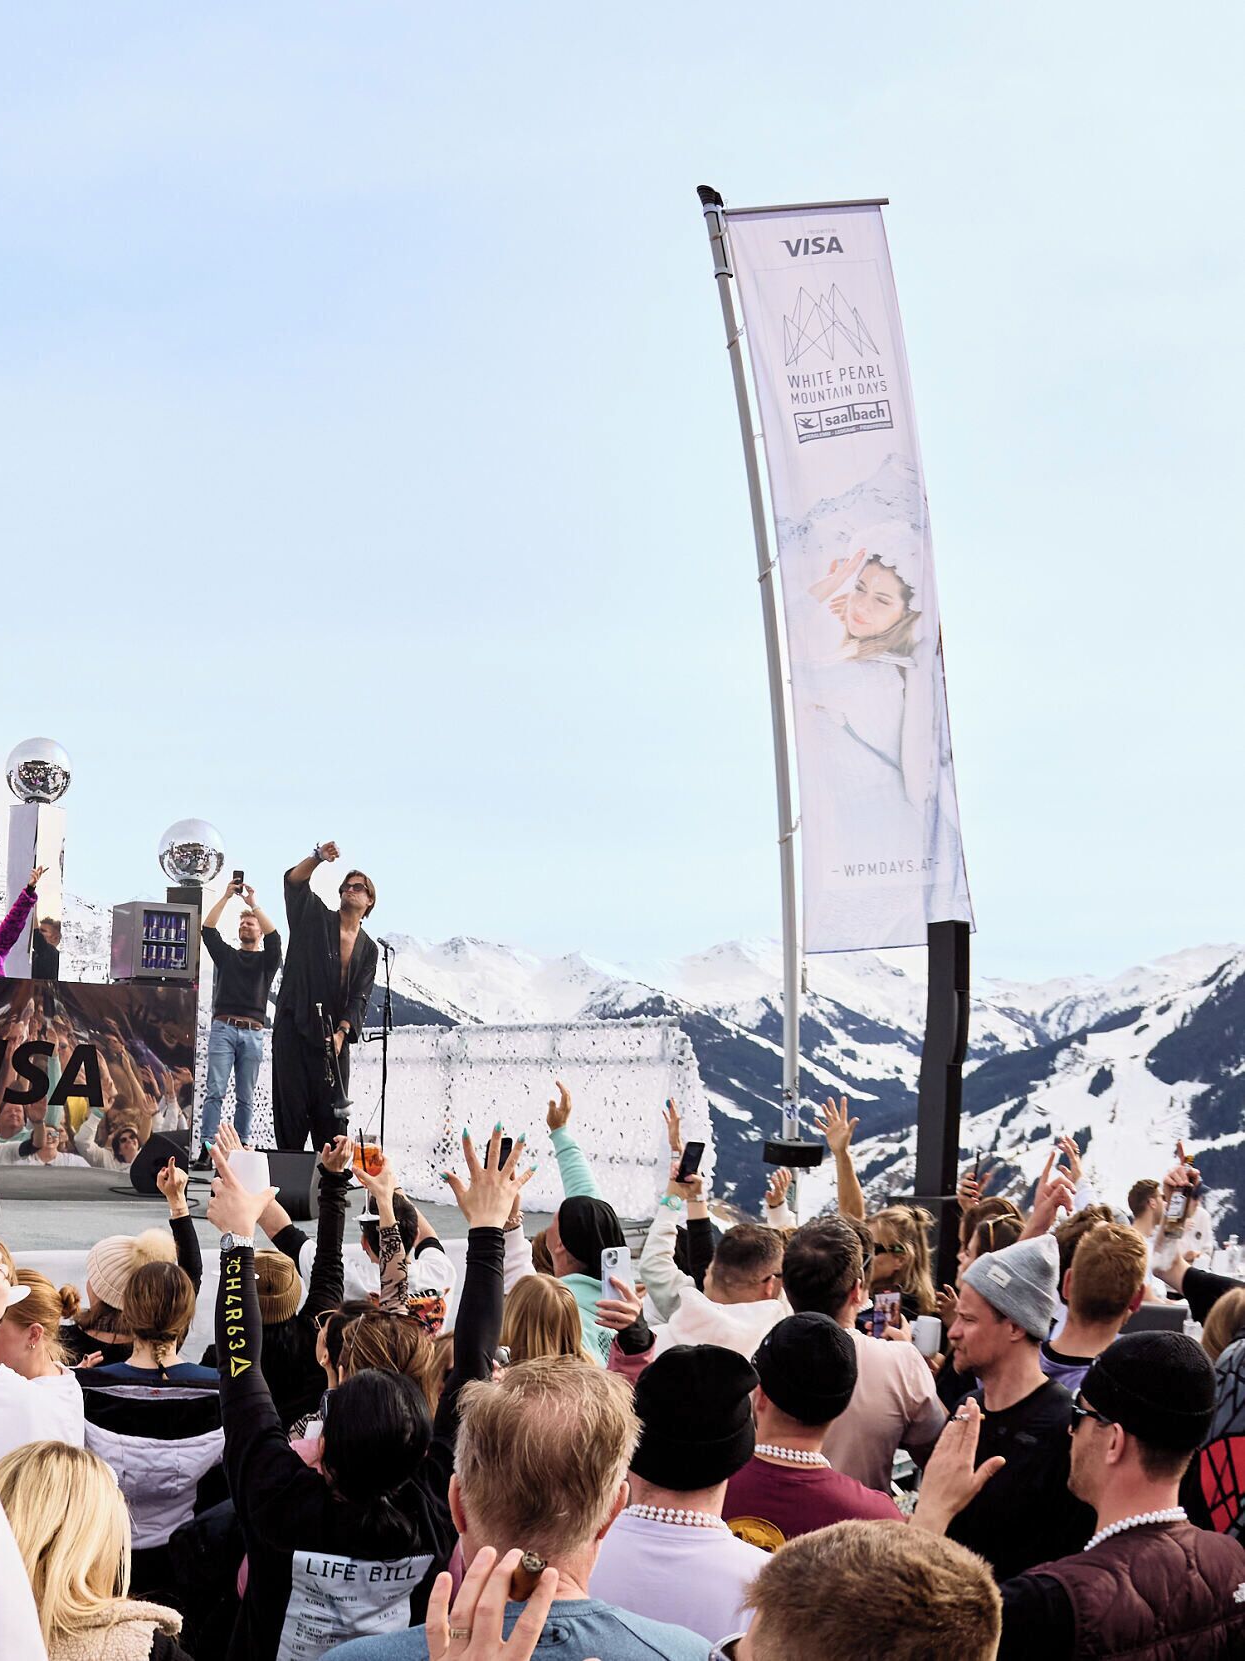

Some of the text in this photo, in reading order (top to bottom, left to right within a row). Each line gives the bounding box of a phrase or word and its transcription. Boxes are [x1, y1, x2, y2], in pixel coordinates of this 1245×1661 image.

[779, 236, 844, 258] VISA
[787, 364, 884, 389] WHITE PEARL
[790, 380, 888, 405] MOUNTAIN DAYS
[825, 402, 885, 427] saalbach
[306, 1557, 417, 1582] LIFE BILL
